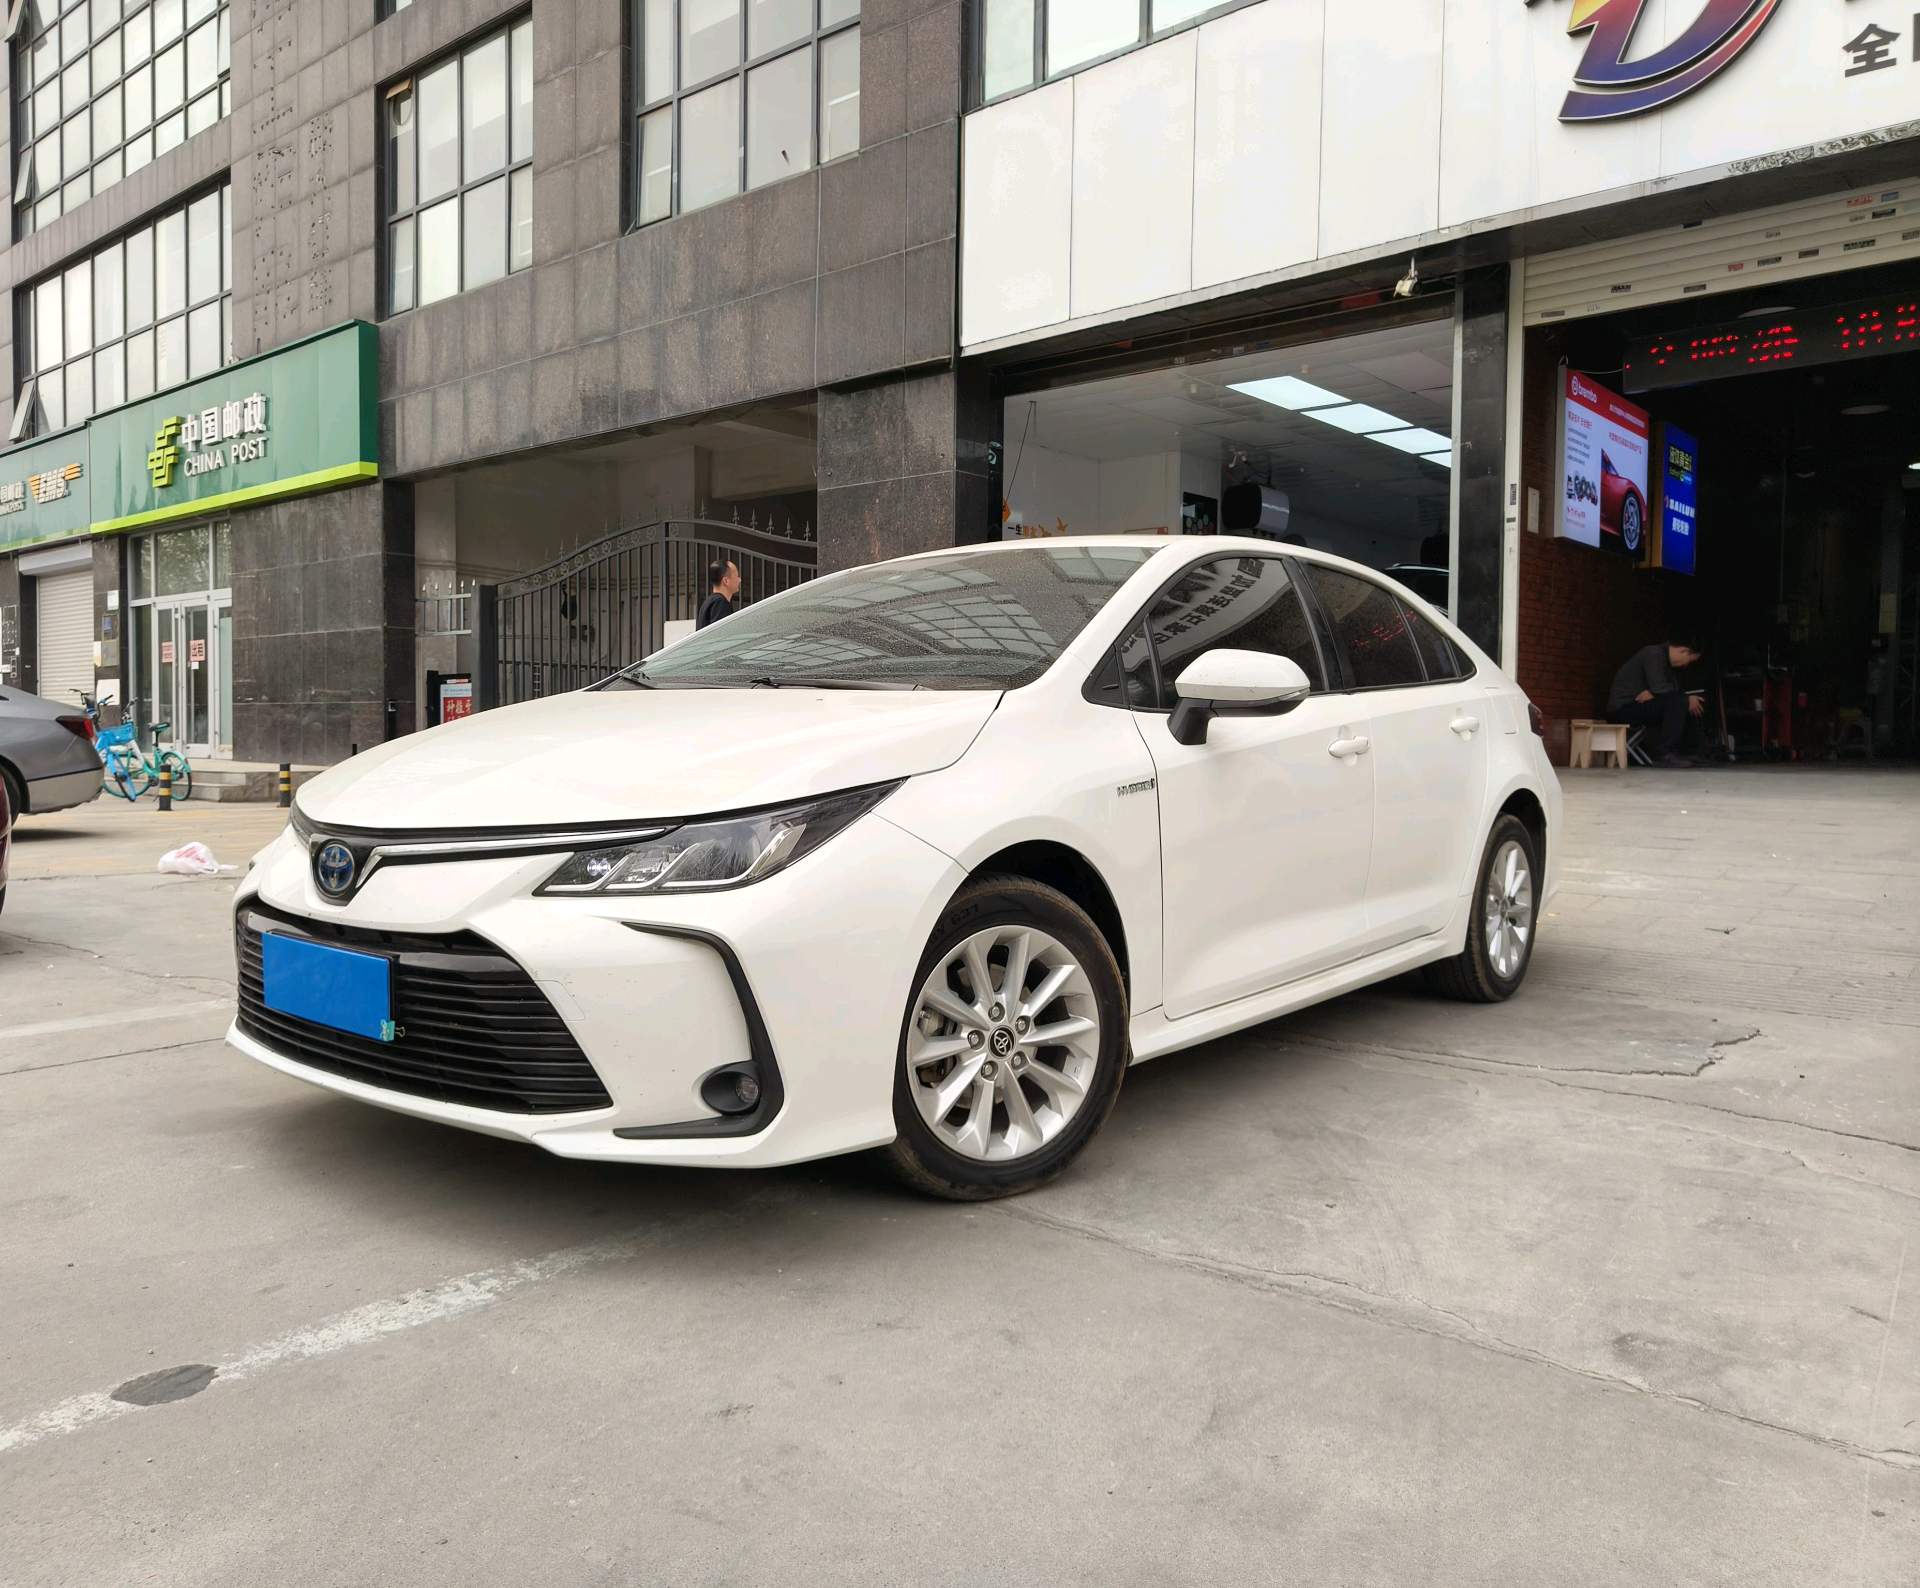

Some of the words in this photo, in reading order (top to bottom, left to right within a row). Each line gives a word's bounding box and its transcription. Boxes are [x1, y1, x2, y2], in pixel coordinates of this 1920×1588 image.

[1842, 14, 1920, 78] 全
[182, 392, 267, 452] 中国邮政
[184, 449, 225, 477] CHINA
[231, 436, 268, 464] POST
